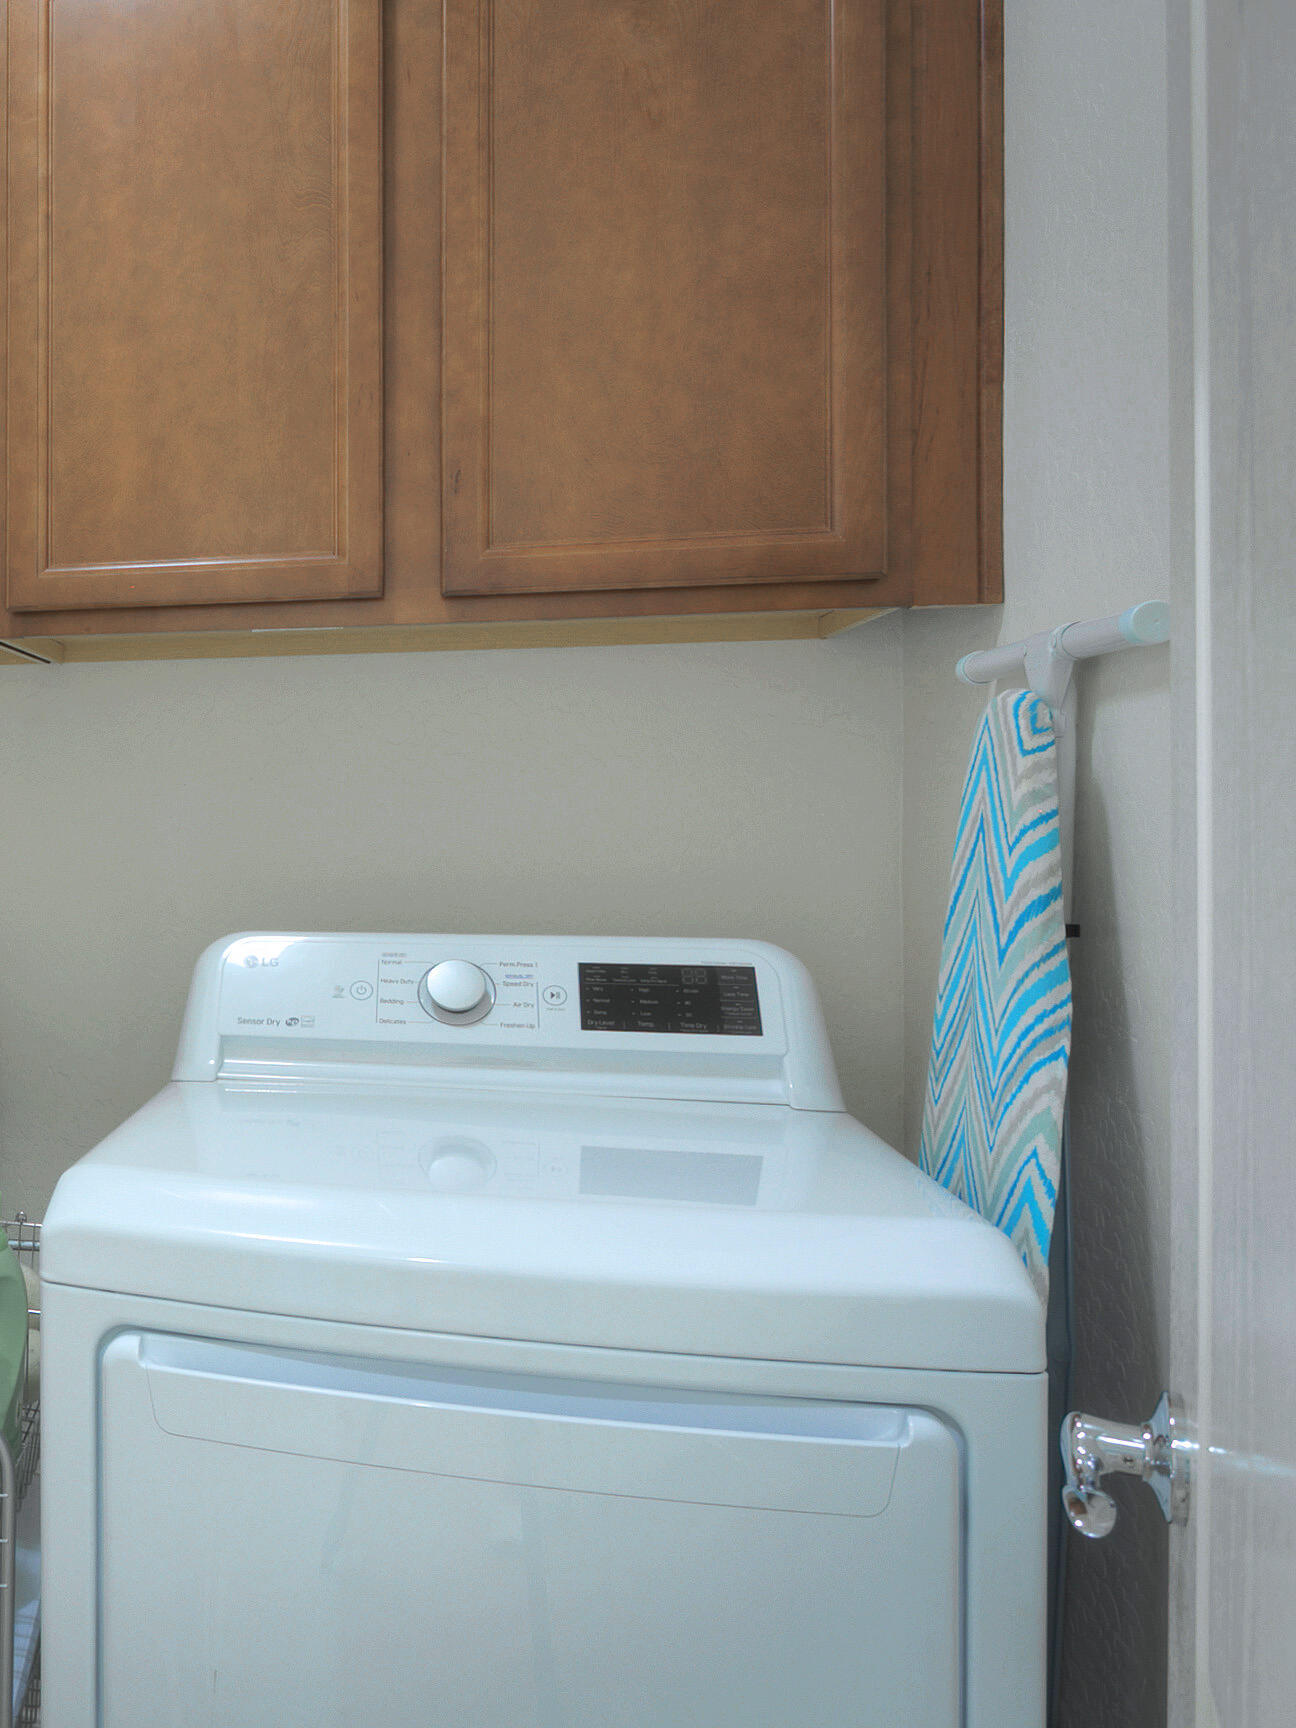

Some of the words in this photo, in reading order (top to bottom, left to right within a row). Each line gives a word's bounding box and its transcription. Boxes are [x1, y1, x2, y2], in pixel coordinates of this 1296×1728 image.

[261, 958, 280, 967] LG
[237, 1016, 264, 1026] Sensor
[266, 1017, 281, 1027] Dry
